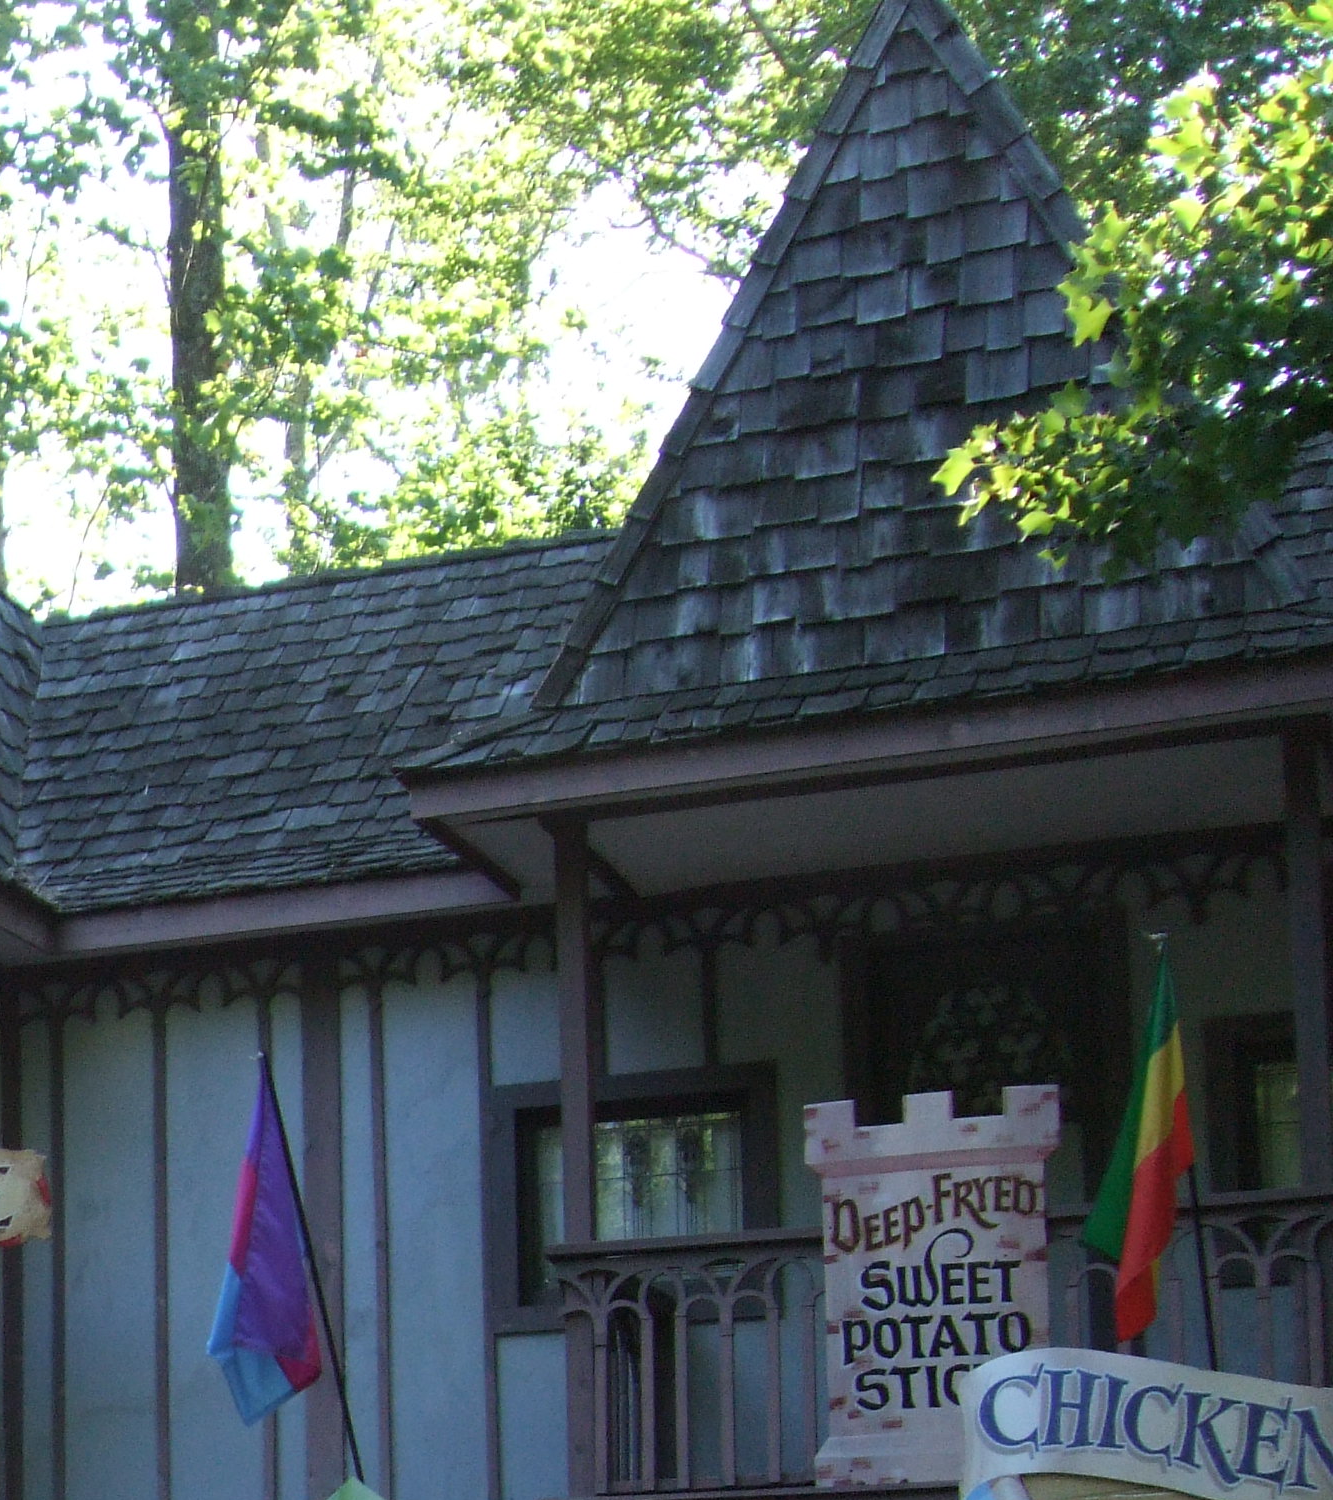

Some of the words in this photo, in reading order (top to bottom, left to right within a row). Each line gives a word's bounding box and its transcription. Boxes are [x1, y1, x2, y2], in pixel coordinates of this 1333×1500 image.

[860, 1227, 1022, 1311] SWEET
[842, 1311, 1032, 1366] POTATO
[855, 1363, 986, 1412] STIC
